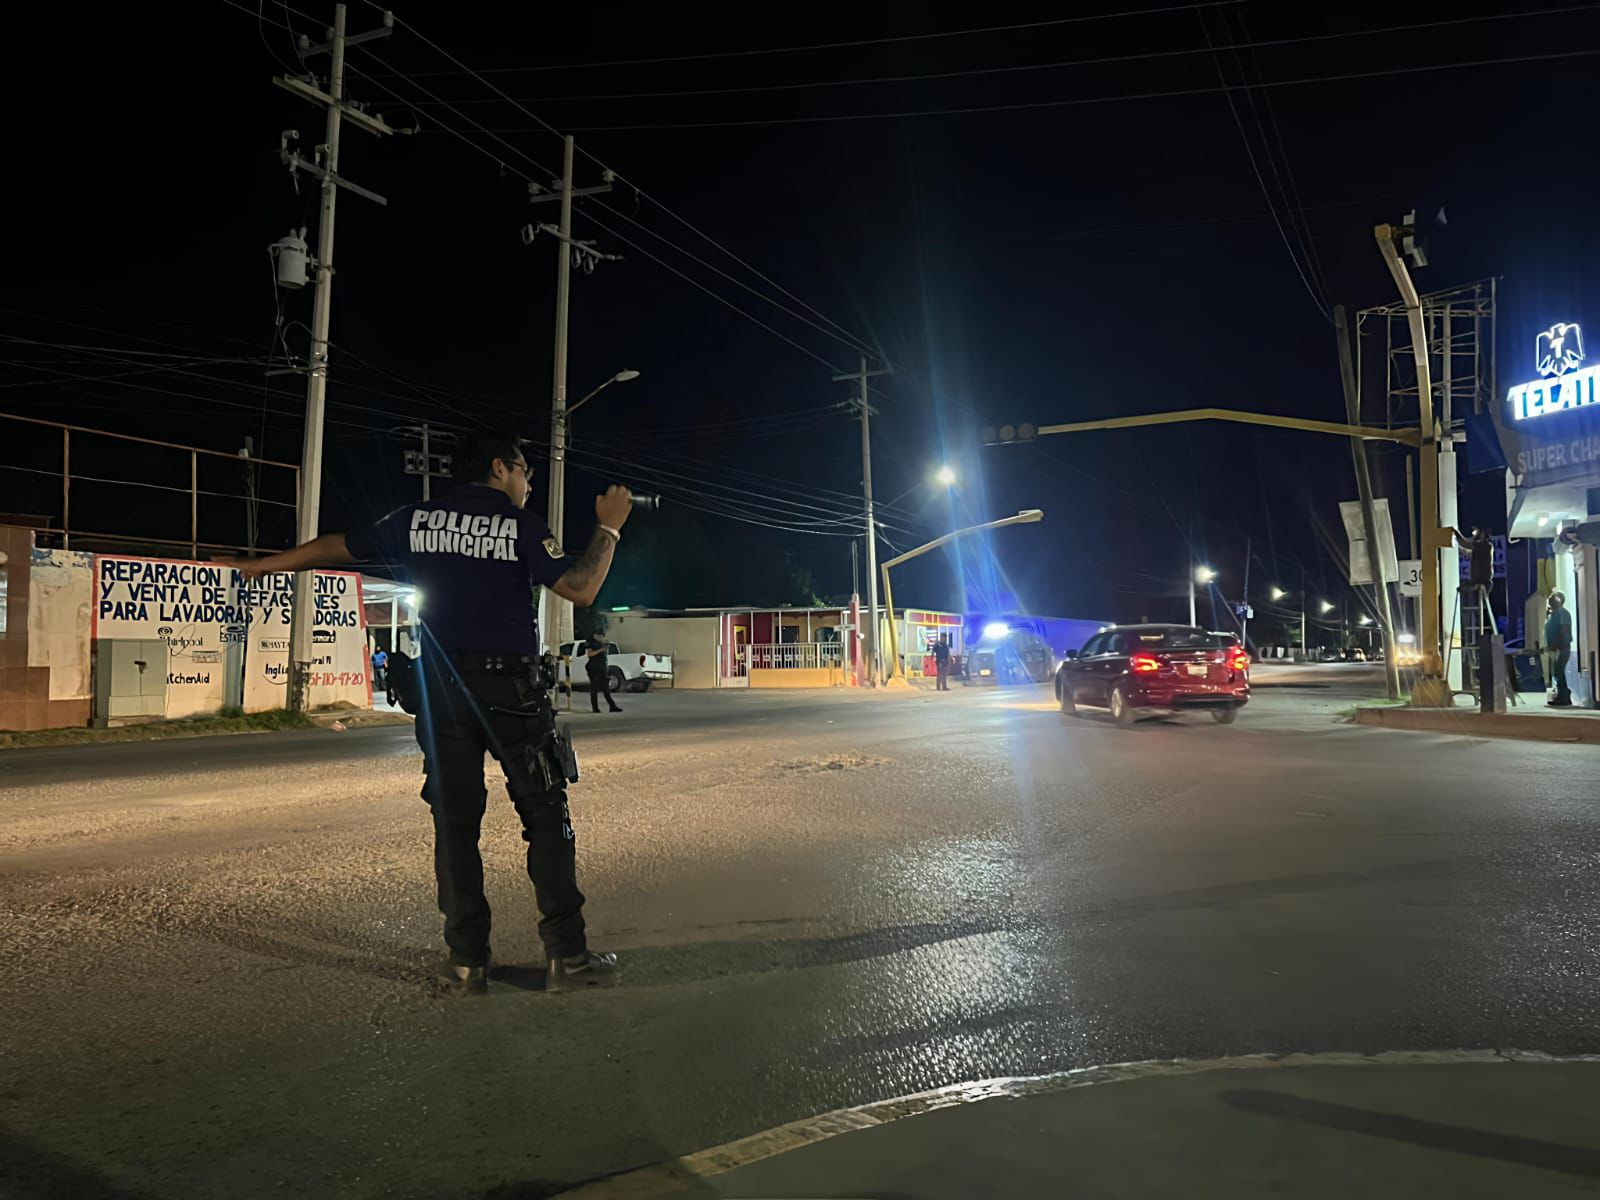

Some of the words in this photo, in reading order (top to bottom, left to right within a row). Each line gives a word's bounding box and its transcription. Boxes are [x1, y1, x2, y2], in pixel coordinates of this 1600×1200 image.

[1517, 443, 1567, 473] SUPER
[410, 509, 519, 539] POLICÍA
[409, 529, 519, 561] MUNICIPAL
[101, 560, 221, 587] REPARACION
[101, 581, 115, 599] Y
[127, 582, 191, 603] VENTA
[202, 587, 226, 605] DE
[100, 600, 149, 621] PARA
[159, 603, 254, 624] LAVADORAS
[263, 607, 273, 625] Y
[281, 608, 357, 627] SDORAS
[160, 636, 203, 648] hirlpool
[166, 672, 210, 684] itchenAid
